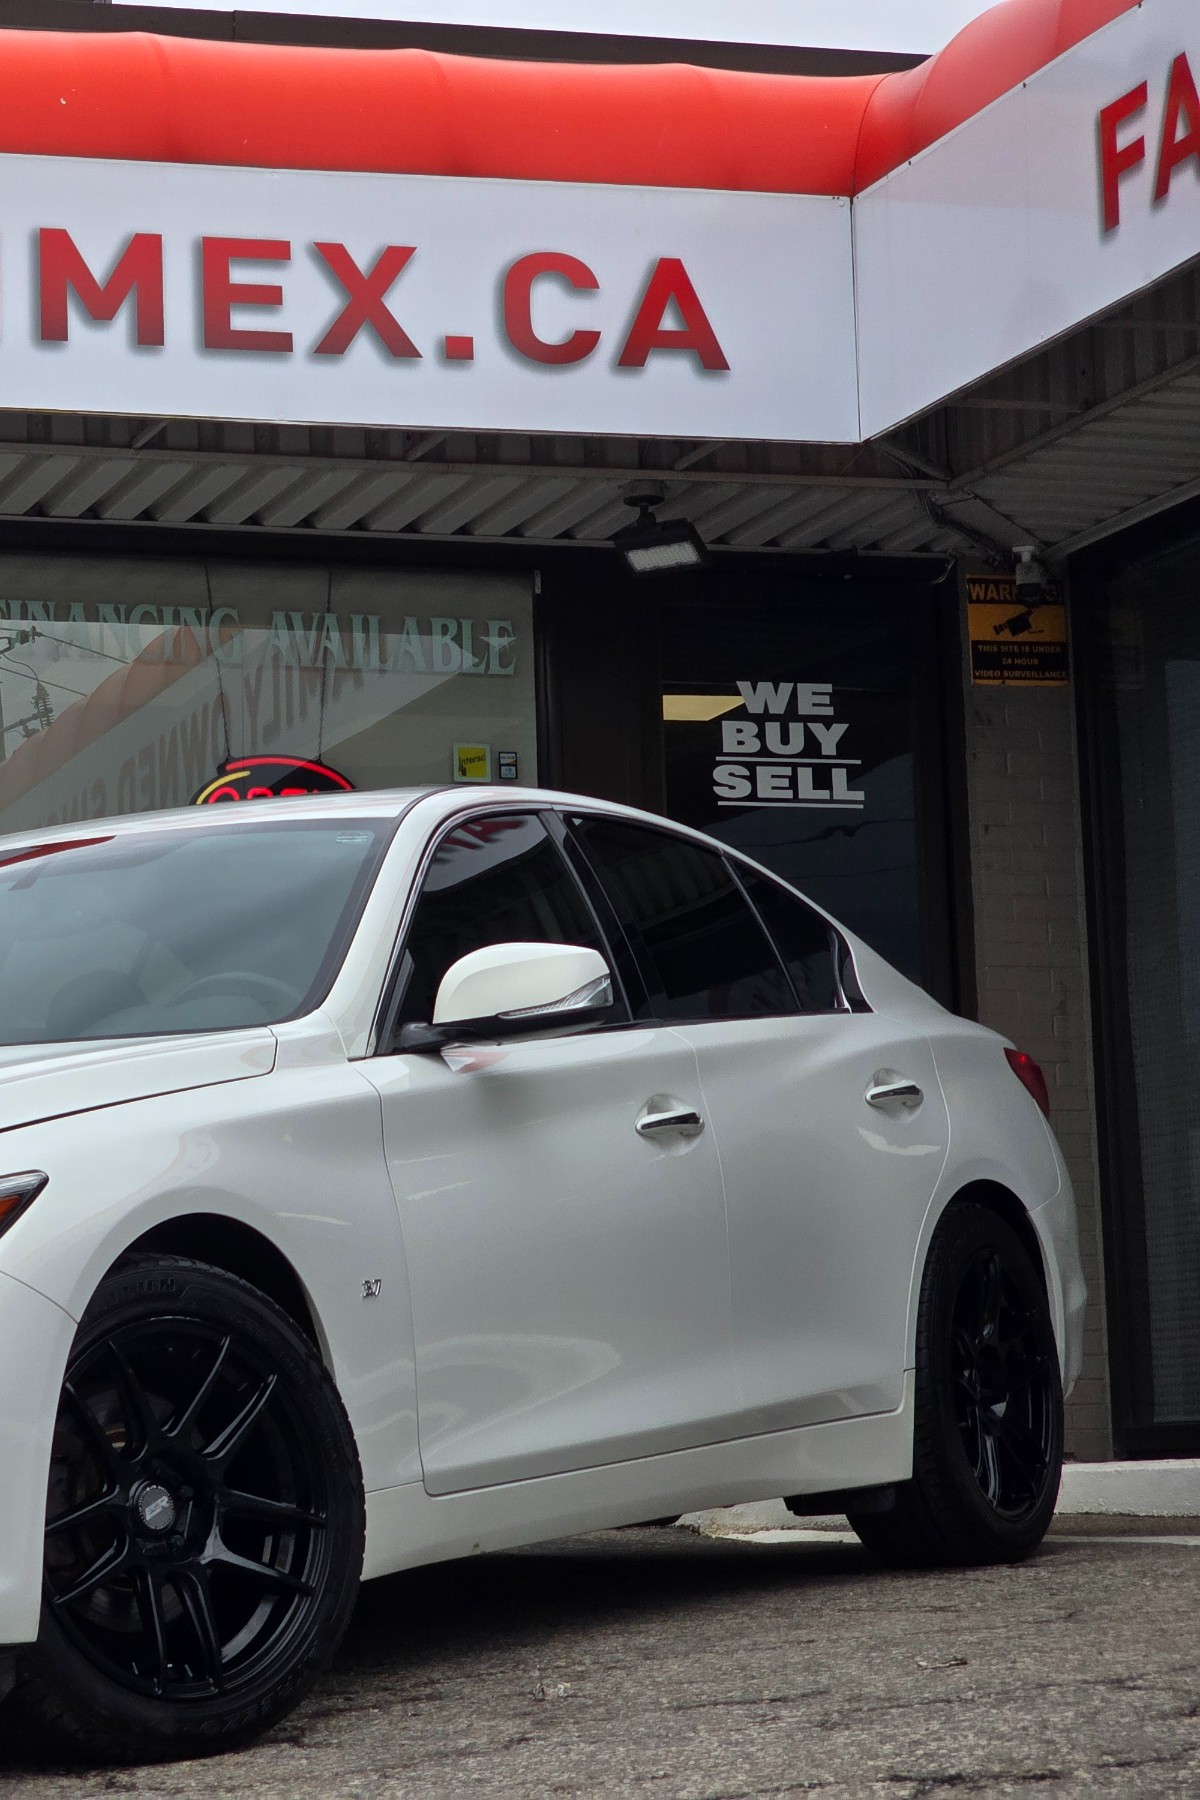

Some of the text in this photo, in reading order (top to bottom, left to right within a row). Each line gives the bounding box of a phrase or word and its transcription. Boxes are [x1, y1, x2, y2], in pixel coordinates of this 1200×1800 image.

[268, 610, 517, 676] AVAILABLE
[977, 645, 998, 653] THIS
[974, 669, 1066, 678] VIDEO SURVEILLANCE
[736, 680, 835, 716] WE
[721, 720, 850, 756] BUY
[712, 764, 865, 801] SELL
